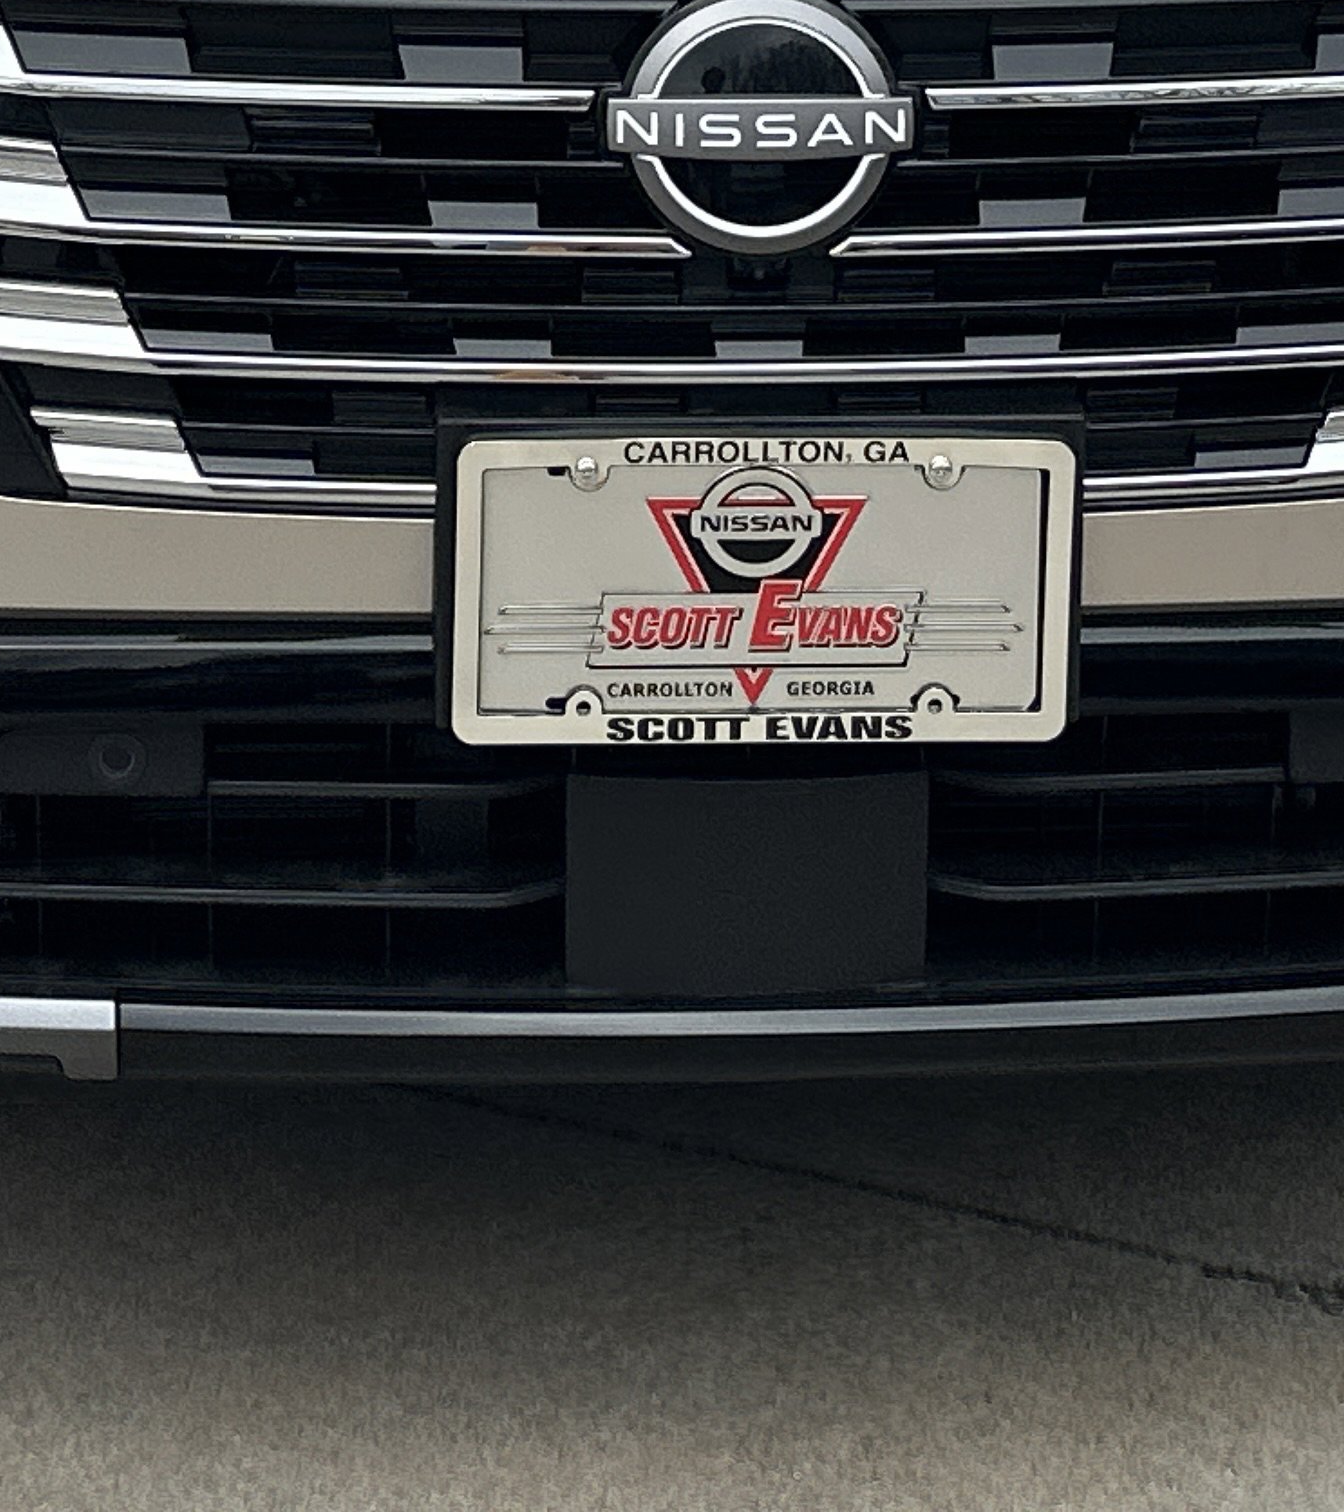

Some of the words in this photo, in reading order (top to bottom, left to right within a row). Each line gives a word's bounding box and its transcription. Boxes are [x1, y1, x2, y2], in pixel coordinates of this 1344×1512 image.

[615, 108, 906, 148] NISSAN
[863, 441, 910, 465] GA
[699, 513, 813, 534] NISSAN
[606, 606, 744, 649] SCOTT
[747, 578, 904, 653] EVANS
[606, 681, 734, 699] CARROLLTON
[786, 680, 875, 698] GEORGIA
[606, 716, 750, 742] SCOTT
[765, 715, 913, 741] EVANS
